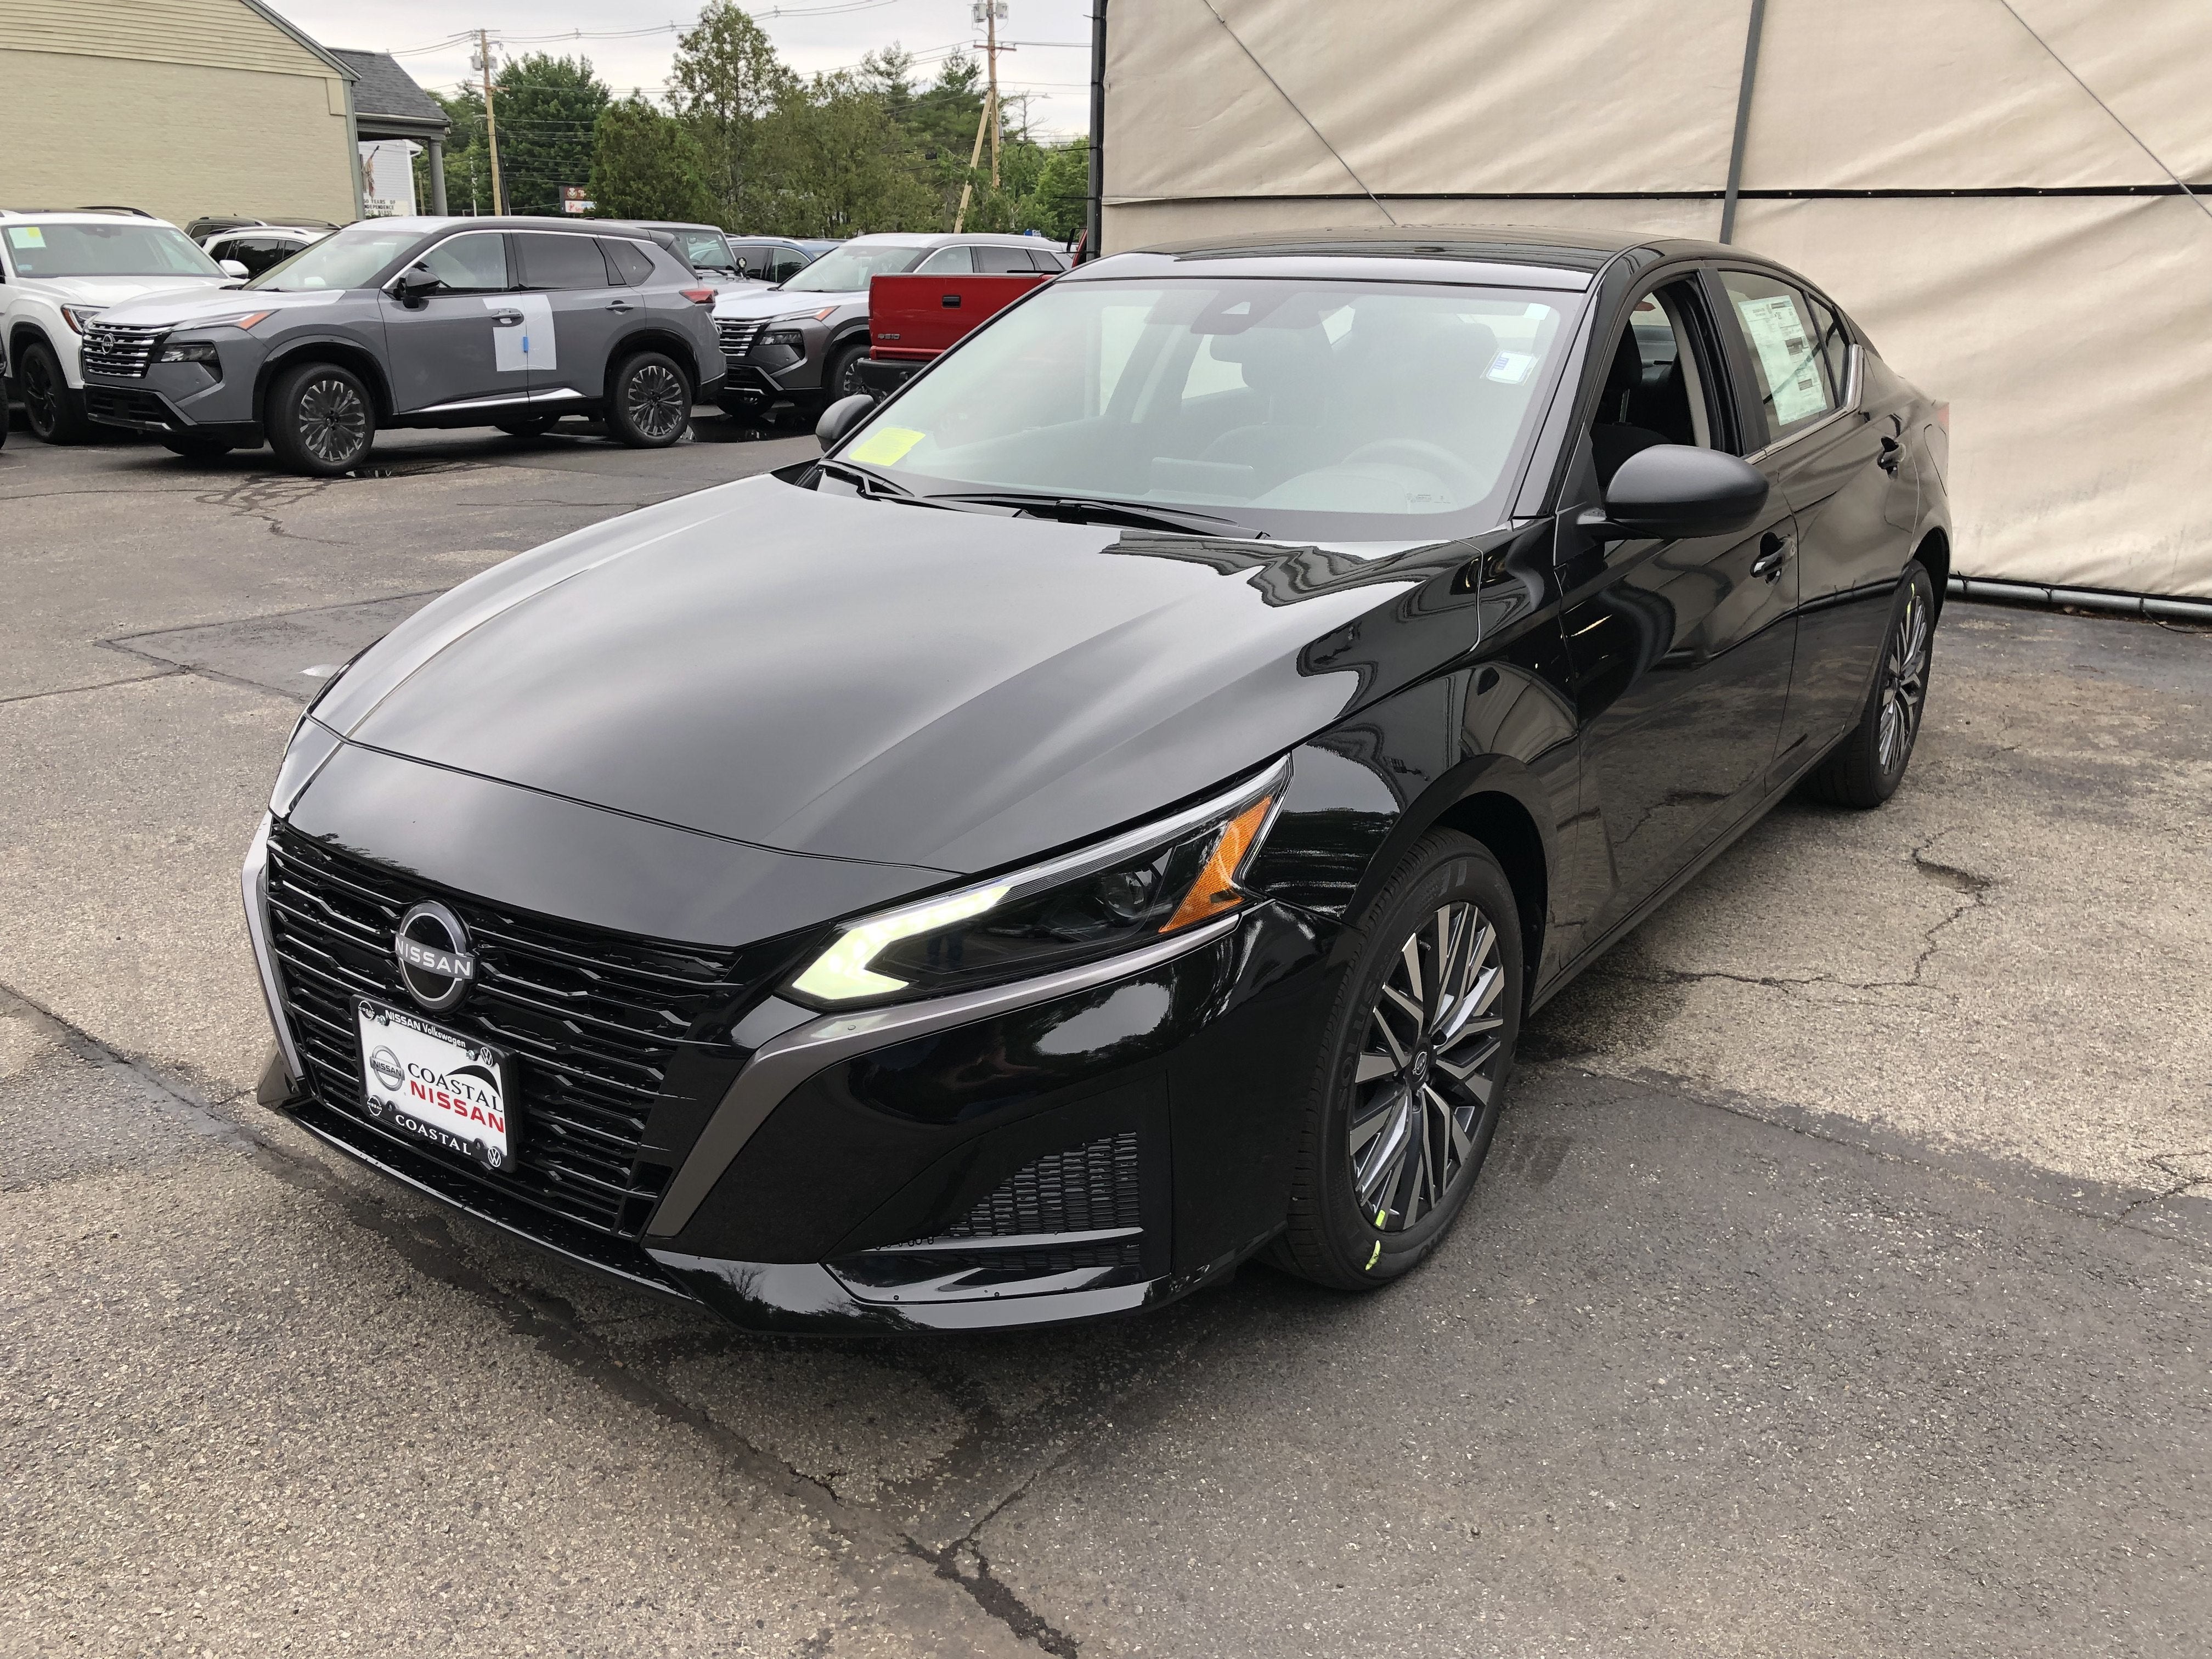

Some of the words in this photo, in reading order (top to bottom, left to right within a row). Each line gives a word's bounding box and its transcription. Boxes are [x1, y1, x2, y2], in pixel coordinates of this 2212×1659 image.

[395, 936, 471, 976] NISSAN
[385, 1009, 421, 1031] NISSAN
[422, 1023, 466, 1048] Volkswagen
[373, 1060, 402, 1077] NISSAN
[408, 1063, 503, 1113] COASTAL
[410, 1080, 504, 1133] NISSAN
[395, 1114, 471, 1156] COASTAL
